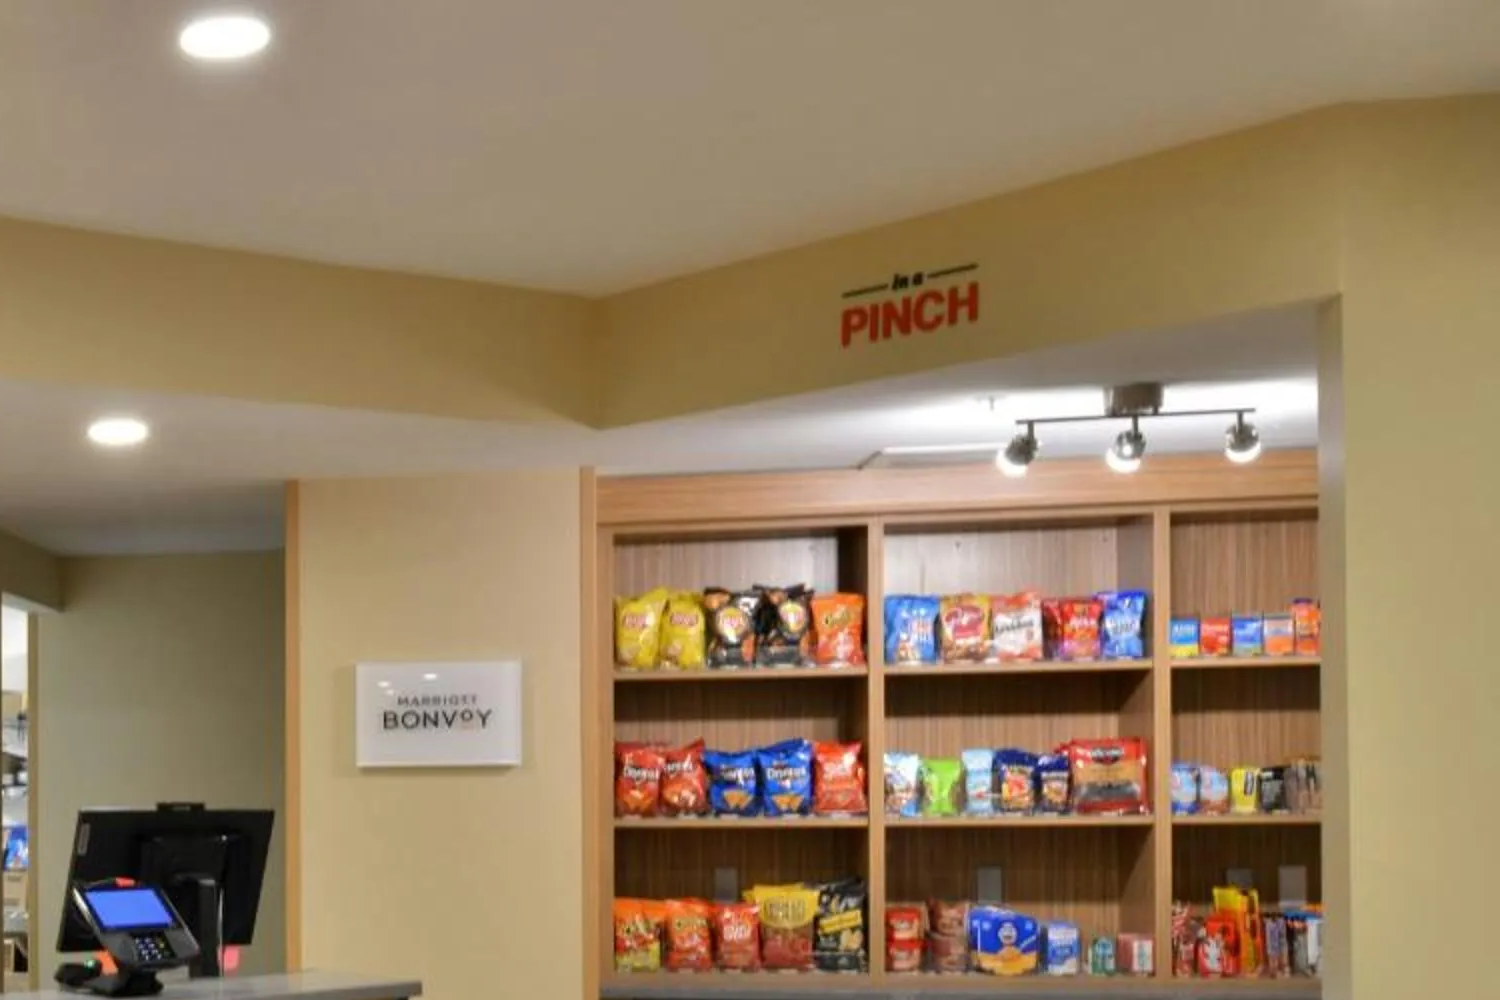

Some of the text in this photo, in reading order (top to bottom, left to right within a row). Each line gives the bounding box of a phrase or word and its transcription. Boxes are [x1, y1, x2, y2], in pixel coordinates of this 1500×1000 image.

[891, 272, 924, 291] in a
[840, 281, 979, 348] PINCH
[397, 694, 478, 706] MARRIOTT
[383, 709, 493, 730] BONVOY
